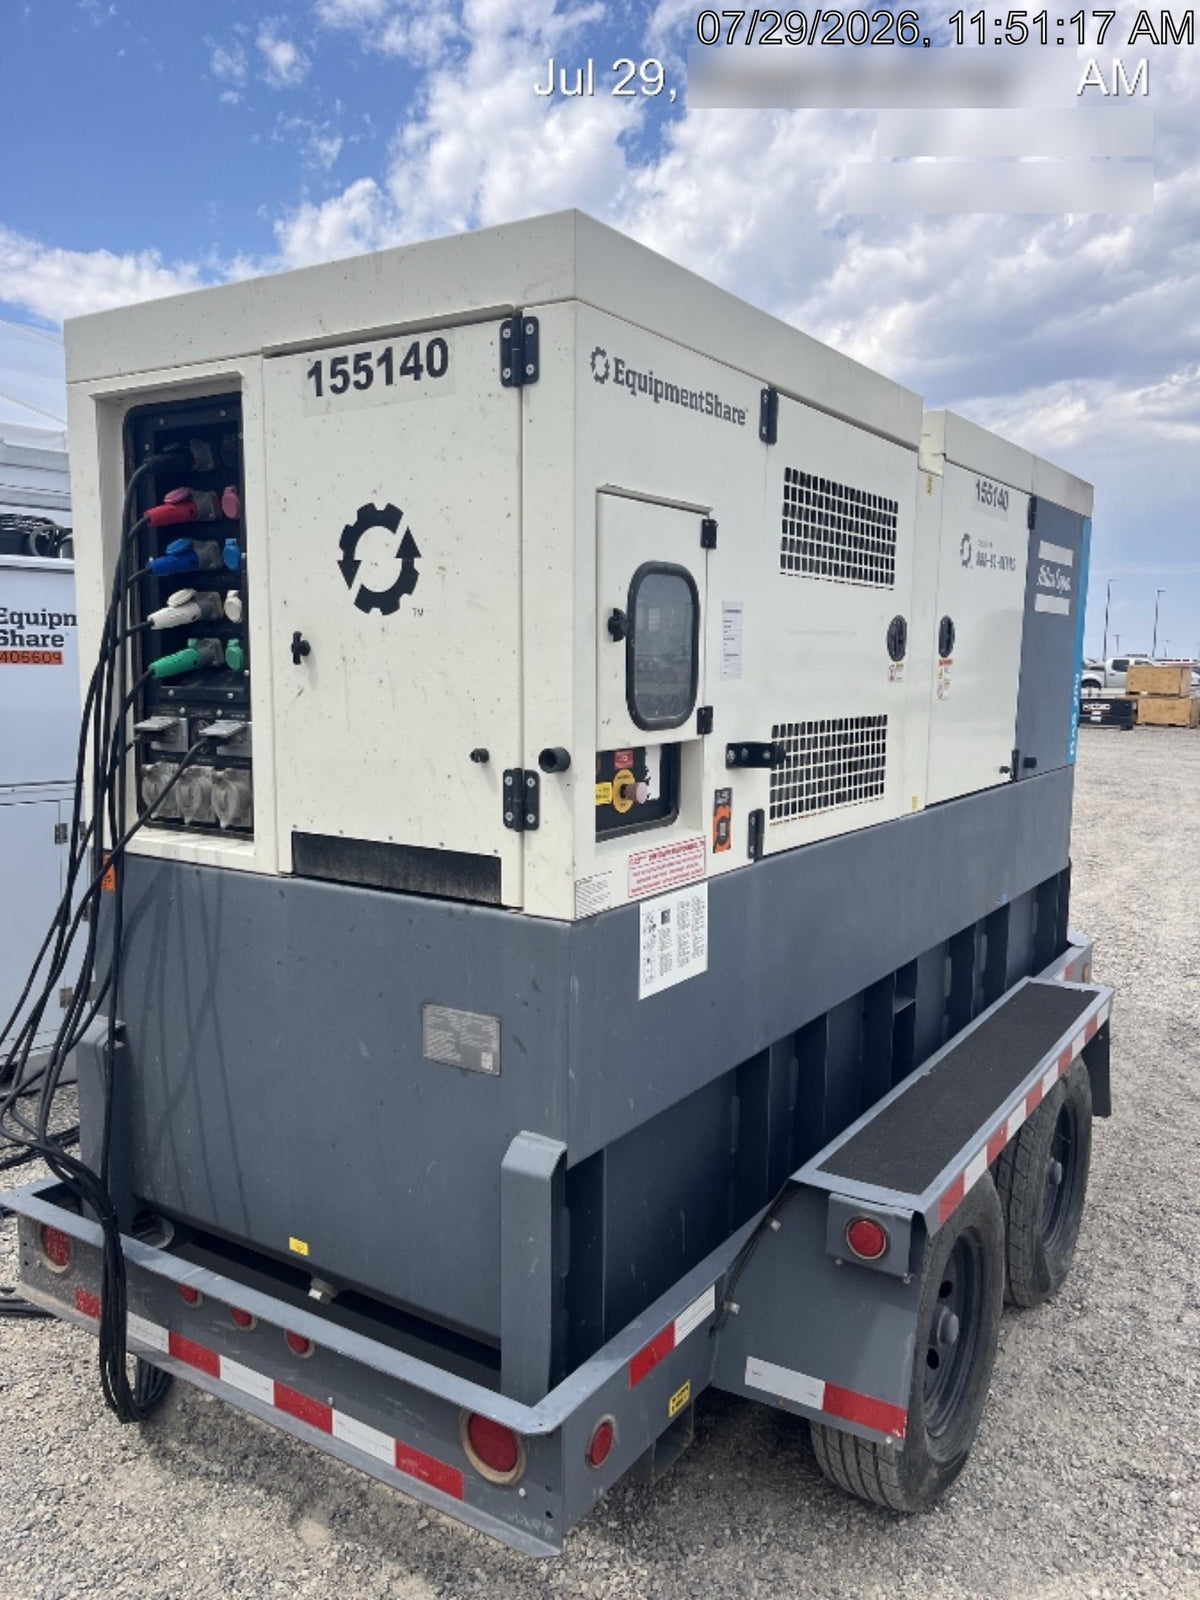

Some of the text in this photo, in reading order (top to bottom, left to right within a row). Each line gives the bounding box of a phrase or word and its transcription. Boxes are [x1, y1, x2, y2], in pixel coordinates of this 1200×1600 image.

[306, 337, 449, 397] 155140
[612, 356, 747, 426] EquipmentShare
[975, 479, 1010, 512] 155140
